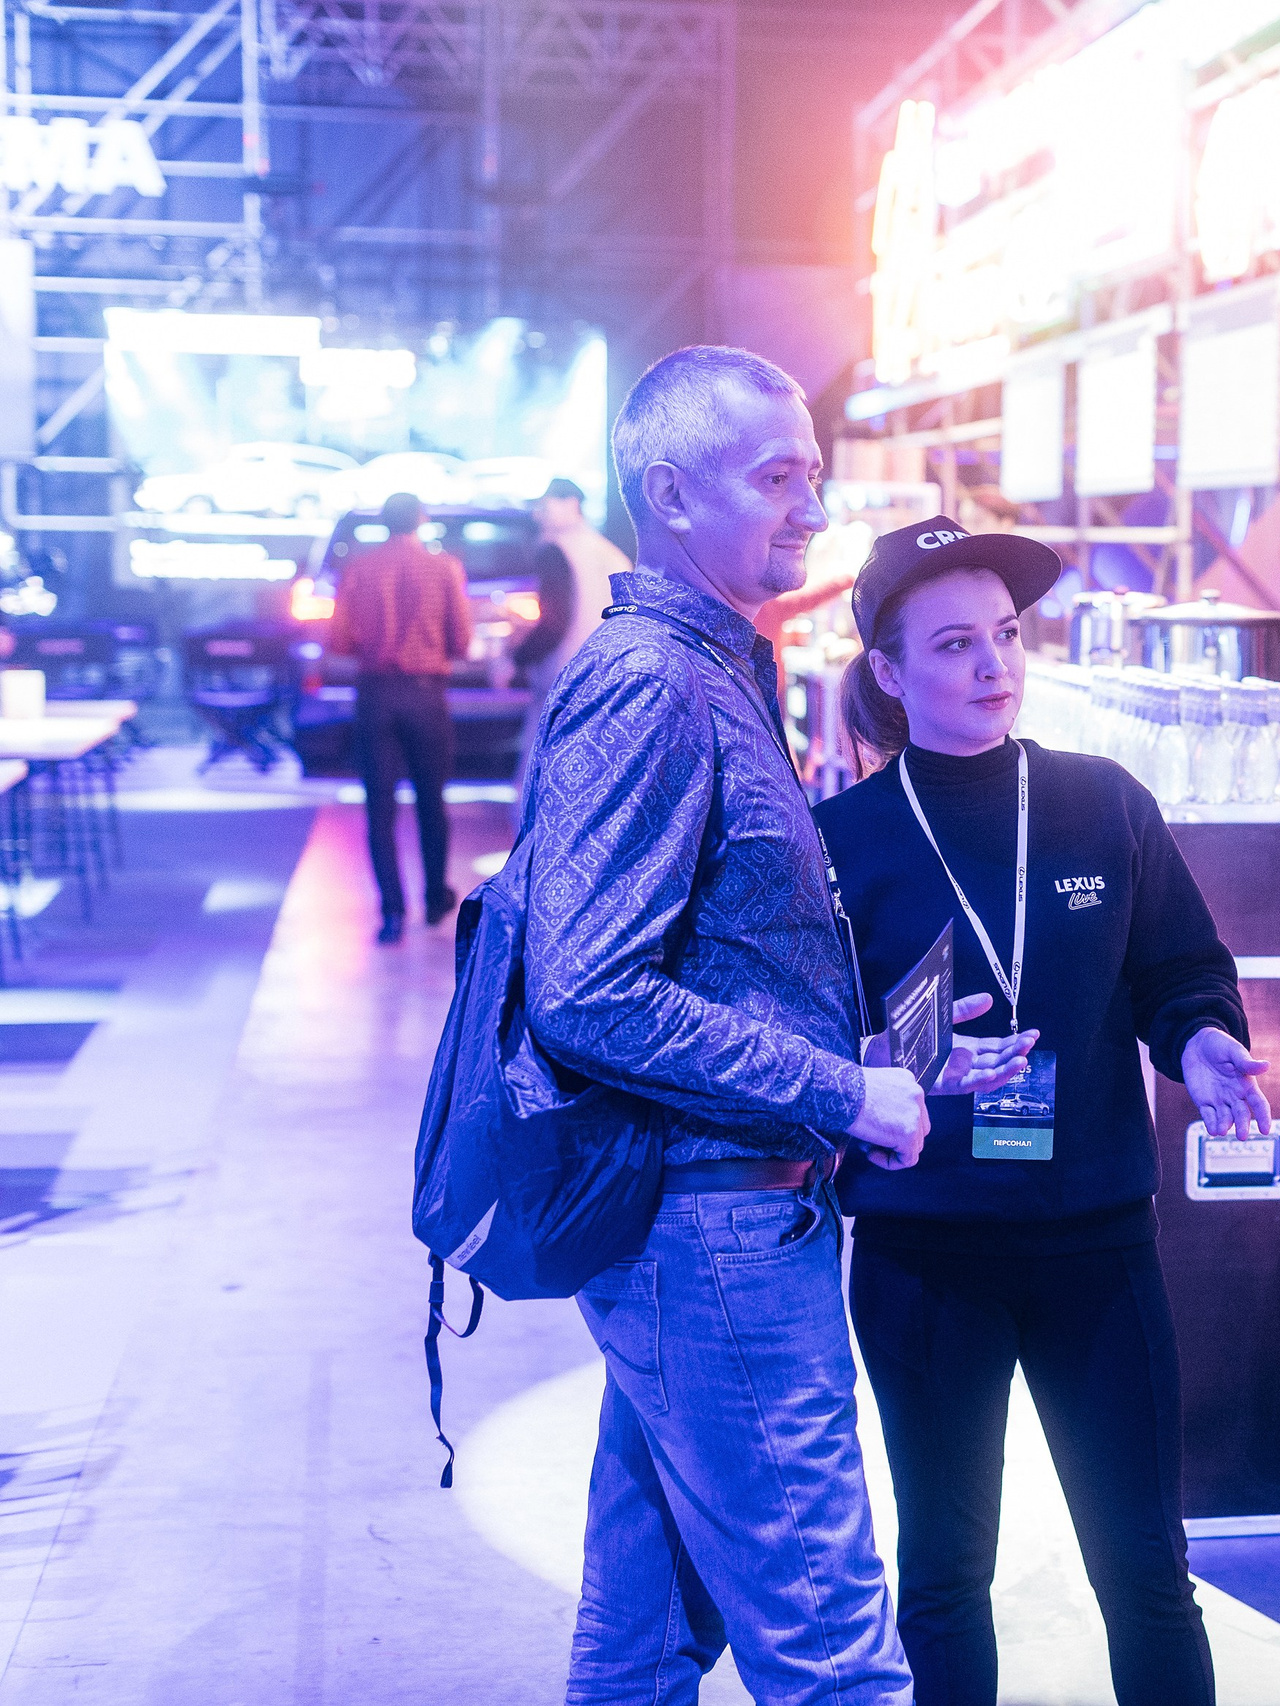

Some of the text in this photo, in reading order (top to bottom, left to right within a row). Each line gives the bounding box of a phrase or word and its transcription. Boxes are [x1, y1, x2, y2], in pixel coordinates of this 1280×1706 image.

[1054, 875, 1106, 894] LEXUS
[1067, 891, 1103, 911] Live
[993, 1139, 1032, 1148] ПЕРСОНАЛ
